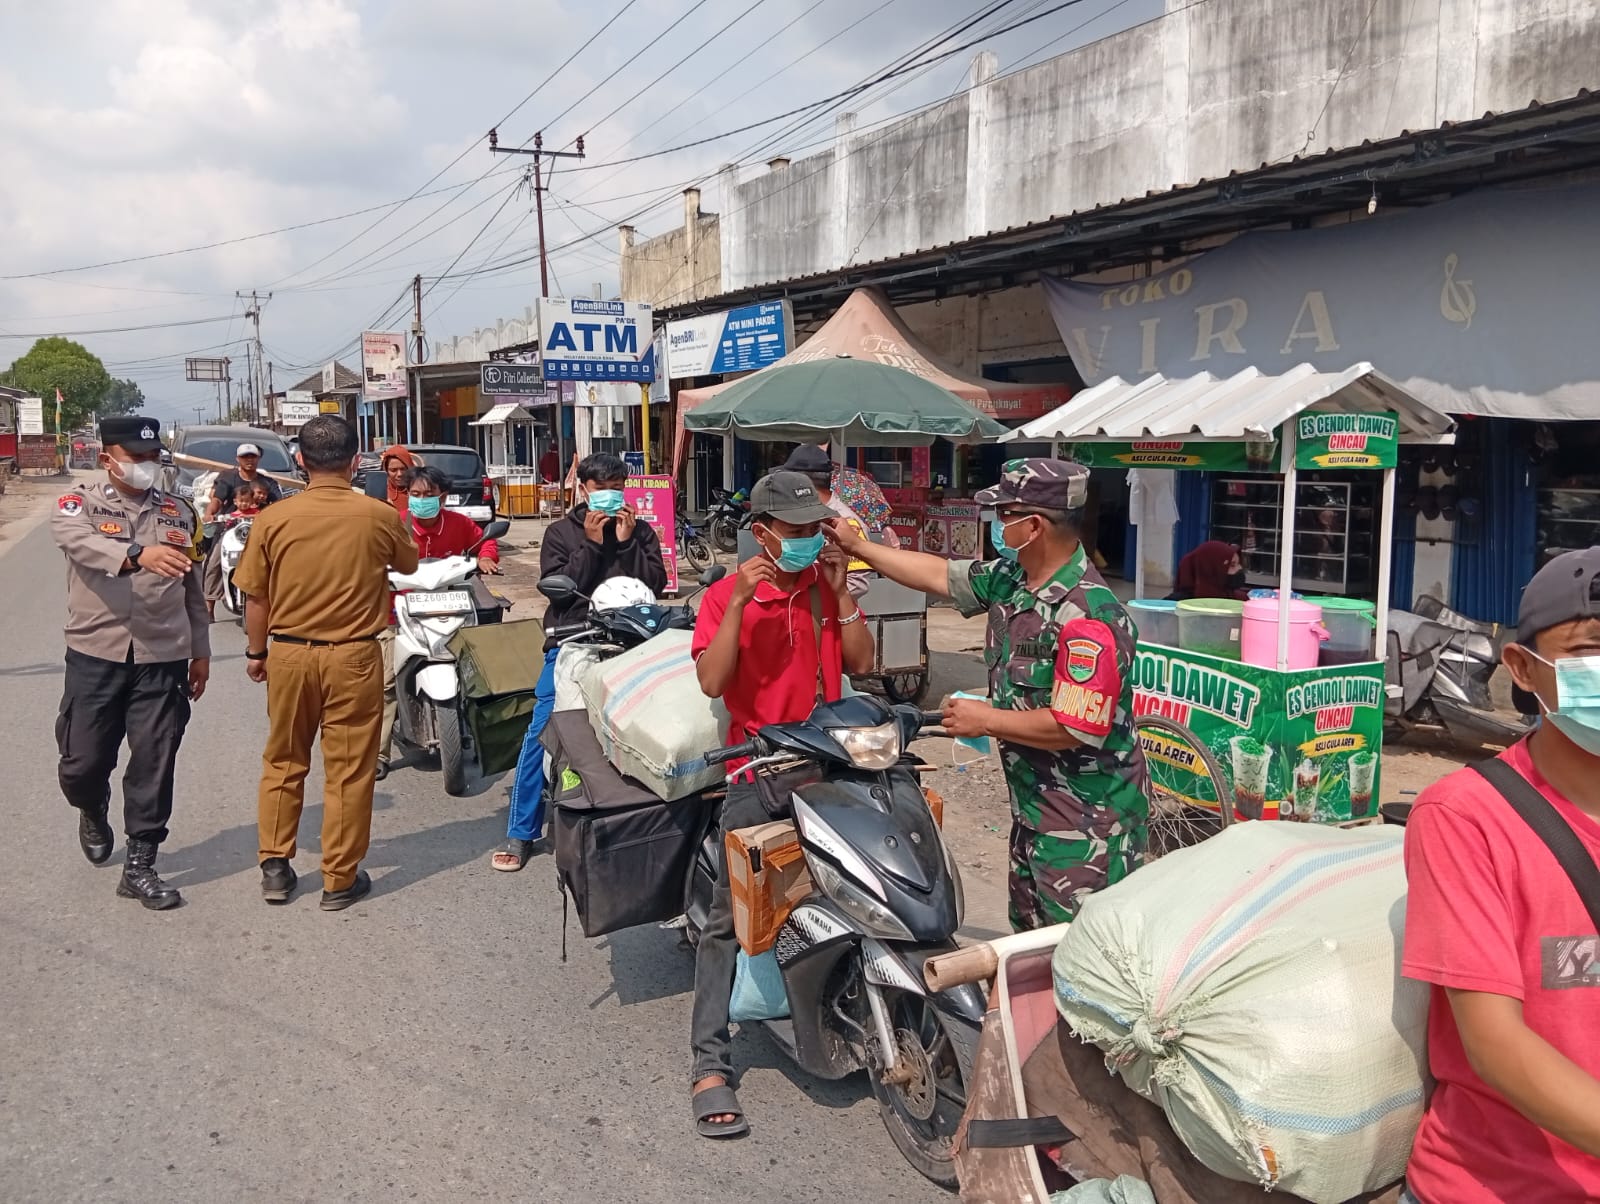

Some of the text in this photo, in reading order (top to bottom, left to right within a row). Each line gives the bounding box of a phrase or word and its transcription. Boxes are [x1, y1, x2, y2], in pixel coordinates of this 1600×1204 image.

[1101, 268, 1193, 311] TOKO
[573, 300, 623, 312] AgenBRILink
[728, 319, 740, 331] ATM
[741, 318, 754, 330] MINI
[1072, 291, 1340, 377] VIRA
[546, 322, 638, 353] ATM
[503, 371, 516, 384] Fitri
[1301, 414, 1395, 437] ES CENDOL DAWET
[1329, 433, 1367, 450] CINCAU
[1147, 455, 1165, 463] GULA
[625, 479, 669, 489] EDAI KIRANA
[157, 517, 189, 530] POLRI
[892, 517, 917, 527] SULTAN
[1131, 654, 1258, 726] DOL DAWET
[1287, 678, 1381, 717] ES CENDOL DAWET
[1132, 692, 1189, 726] NCAU
[1316, 706, 1353, 731] CINCAU
[1142, 738, 1195, 766] ULA AREN
[1315, 737, 1355, 752] ASLI GULA AREN
[807, 909, 832, 936] YAMAHA
